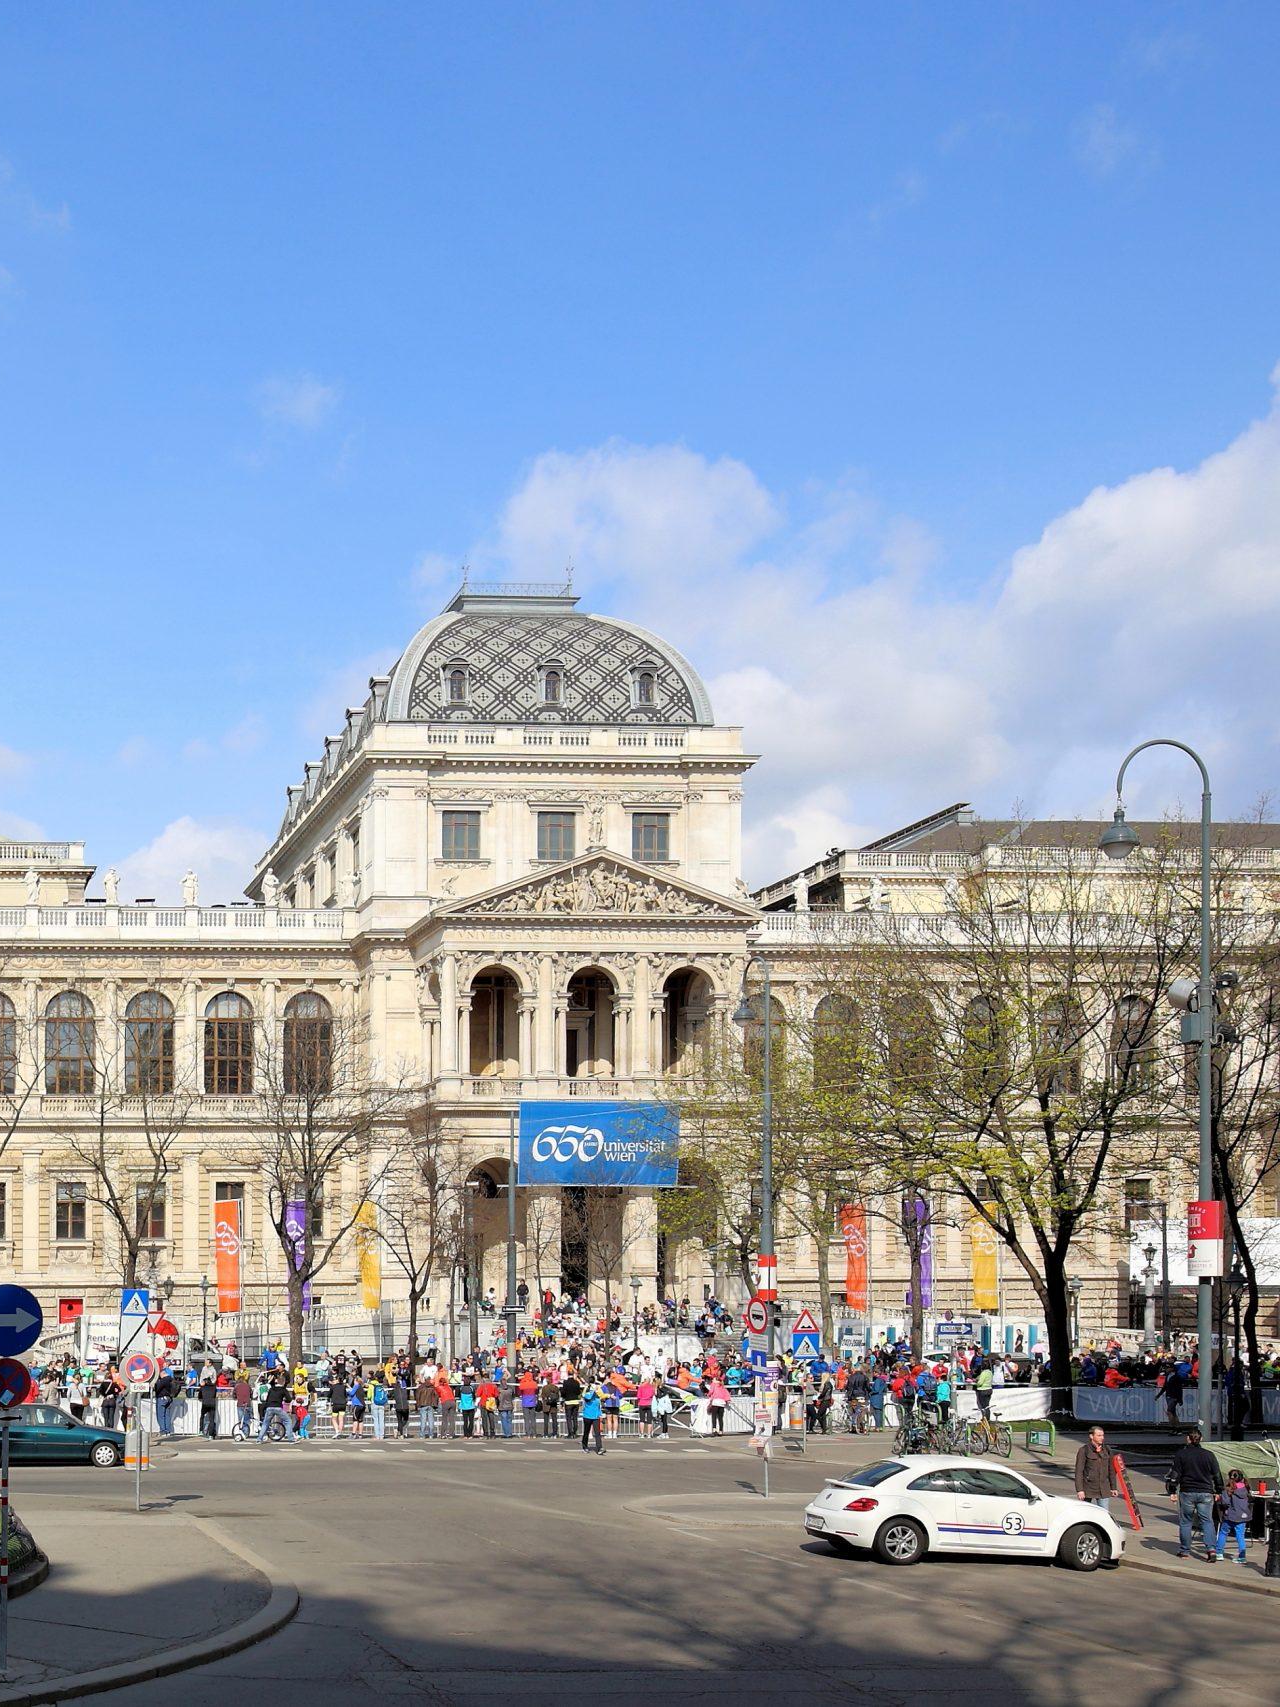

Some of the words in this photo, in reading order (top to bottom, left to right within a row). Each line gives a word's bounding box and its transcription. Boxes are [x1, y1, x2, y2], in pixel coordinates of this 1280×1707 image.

[532, 1124, 604, 1163] 650
[603, 1138, 666, 1153] universität
[604, 1151, 636, 1162] wien
[1004, 1517, 1023, 1531] 53
